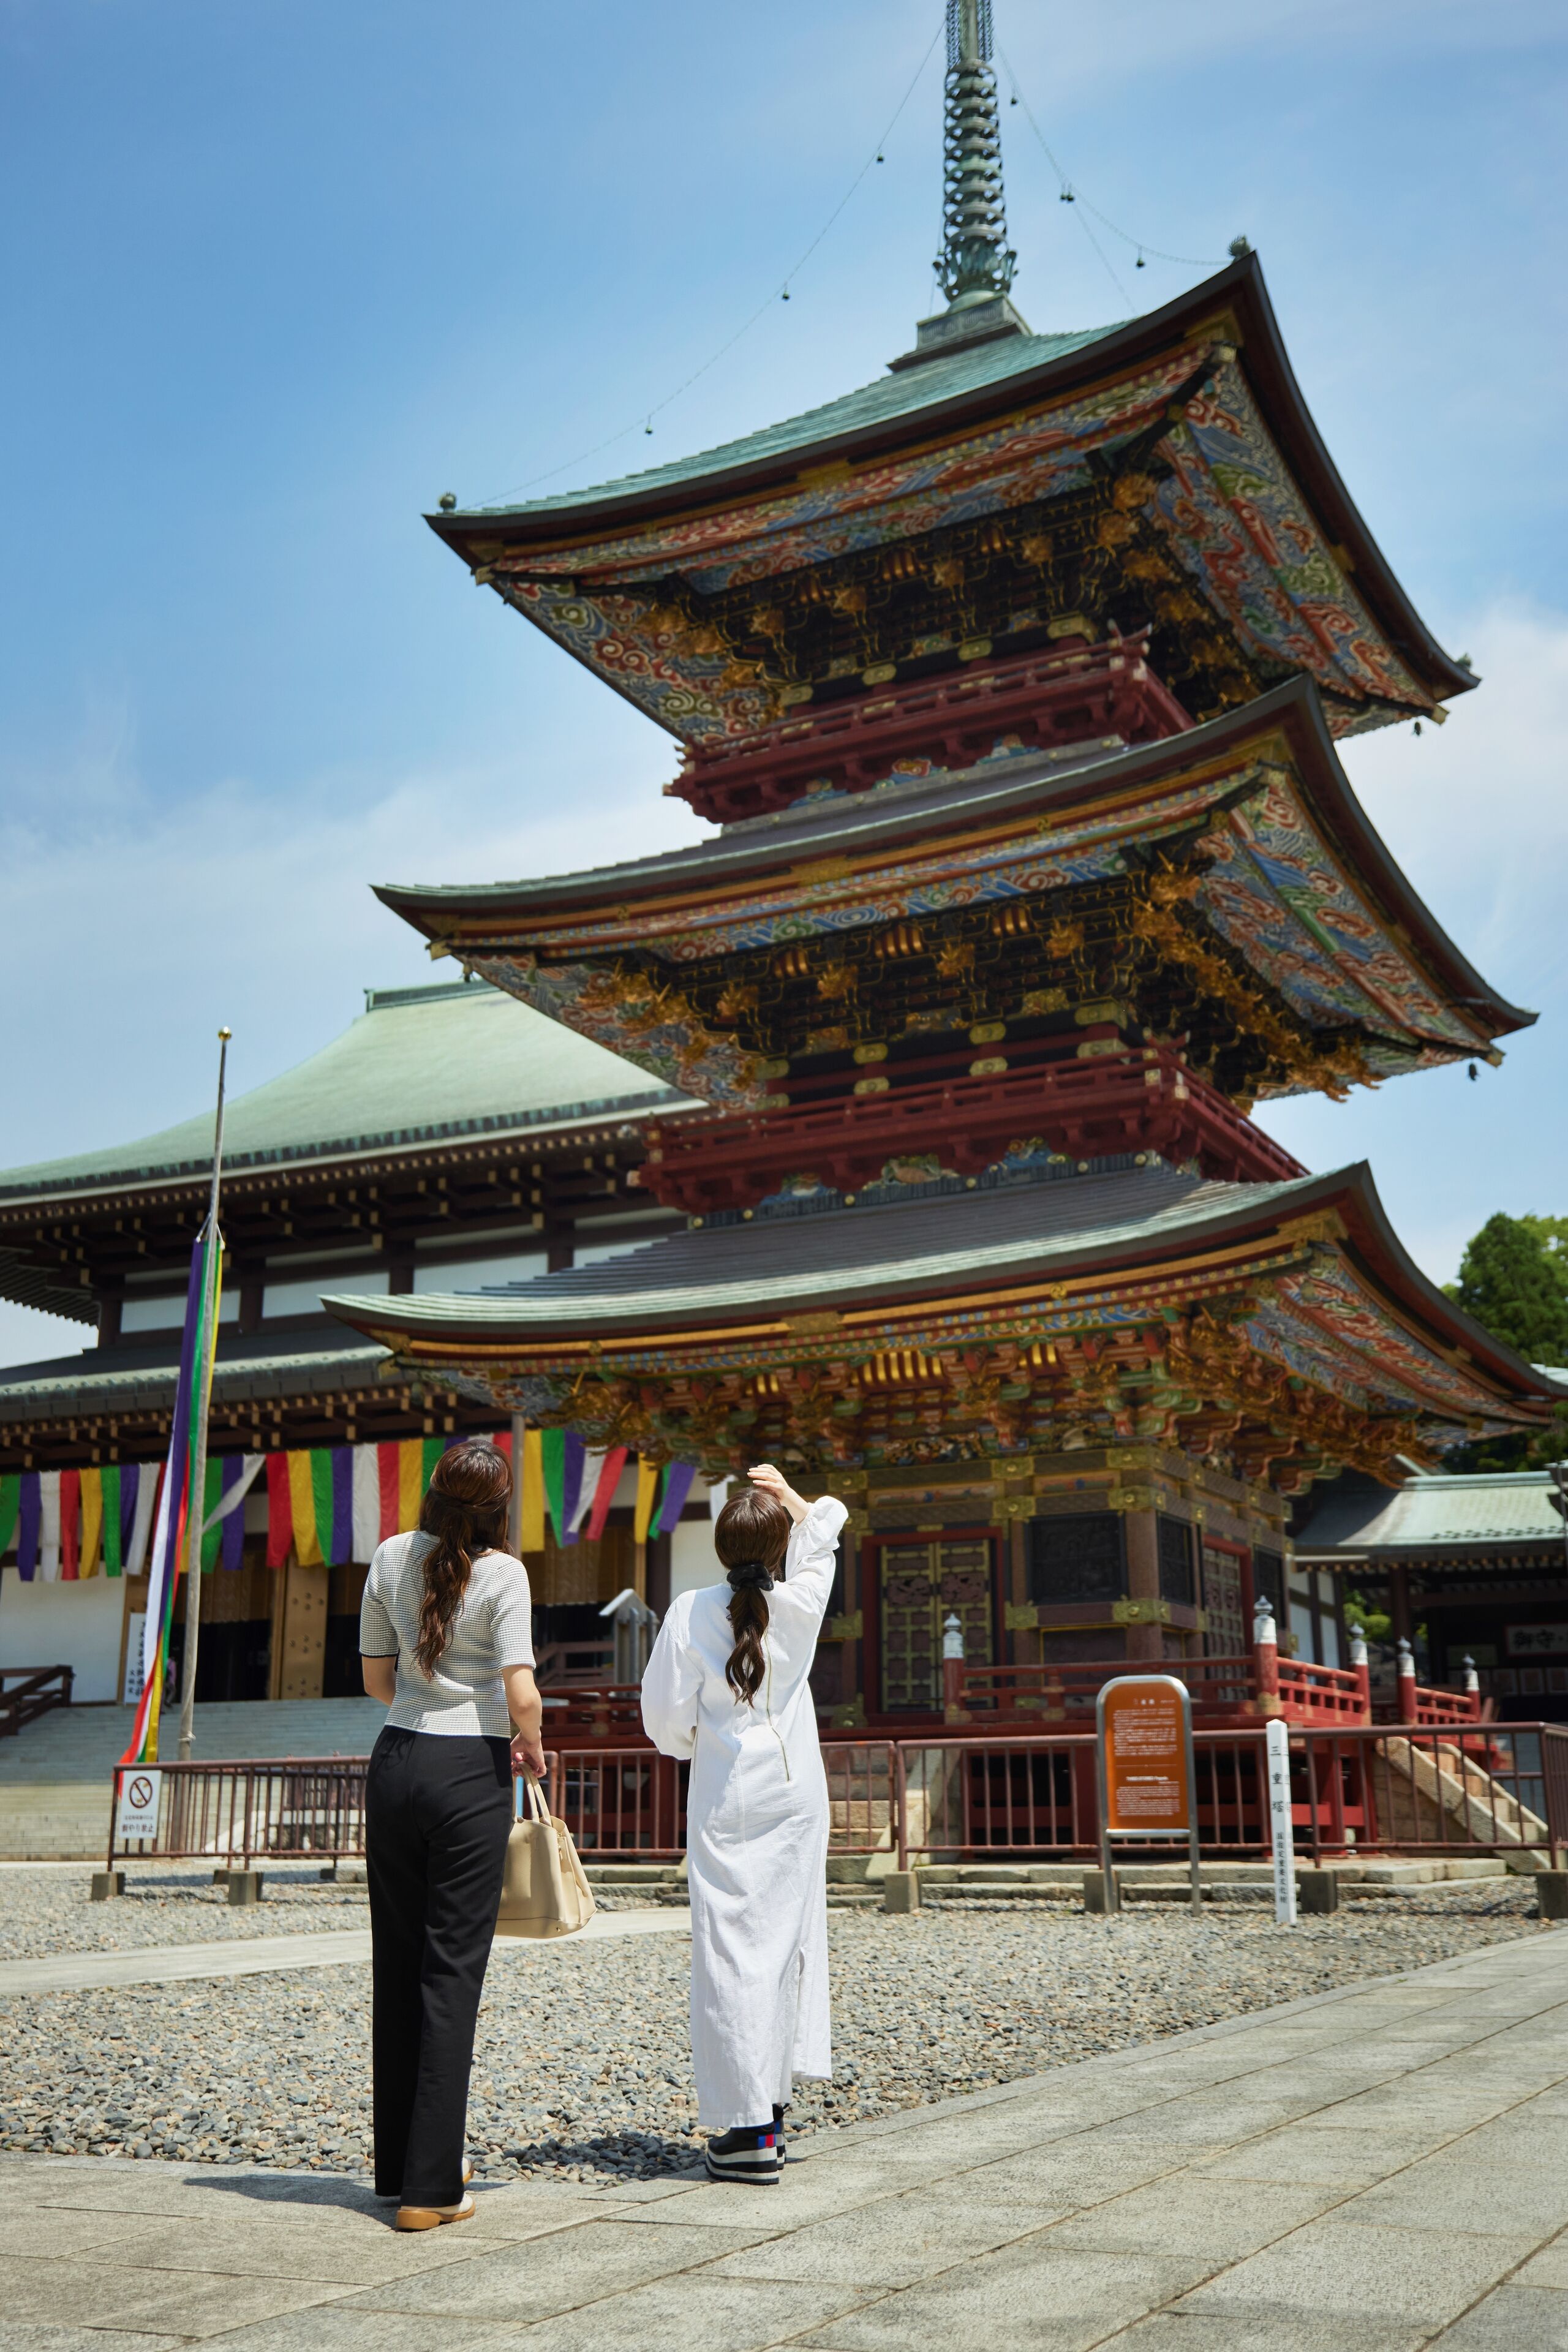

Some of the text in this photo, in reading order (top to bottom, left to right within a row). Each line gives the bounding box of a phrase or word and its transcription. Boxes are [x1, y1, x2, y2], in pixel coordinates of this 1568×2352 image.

[1513, 1629, 1568, 1649] 御守・
[1270, 1745, 1283, 1812] 三重塔
